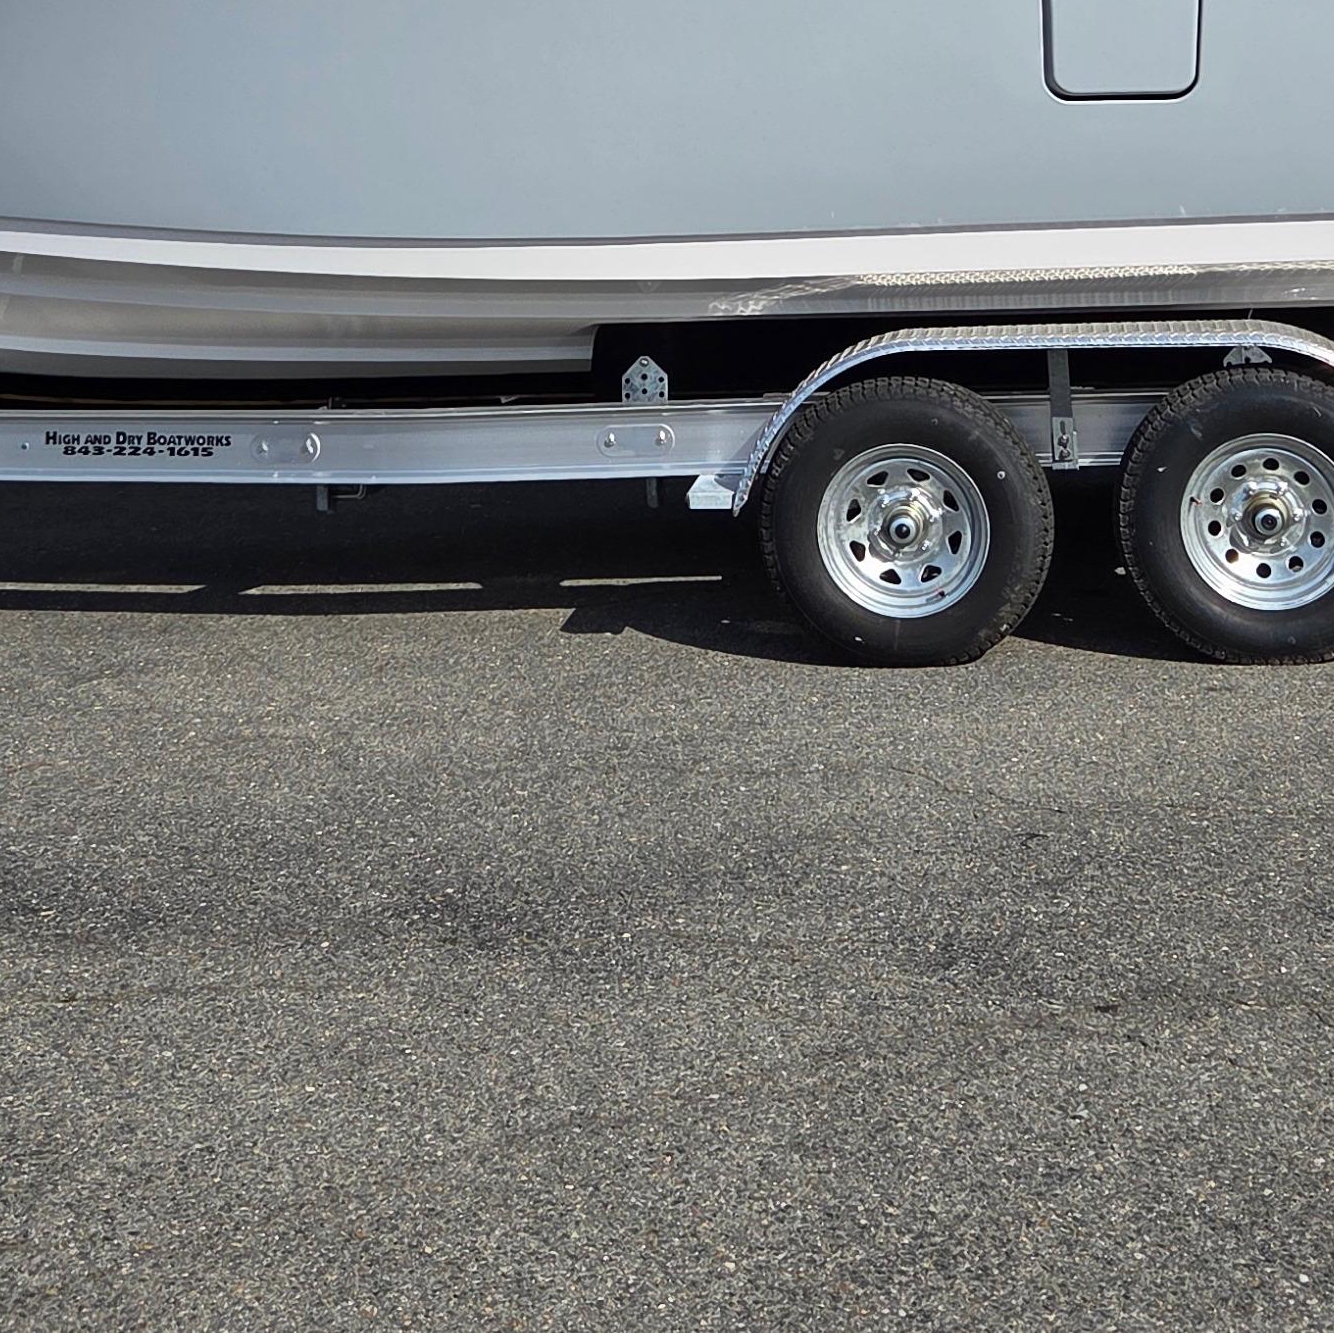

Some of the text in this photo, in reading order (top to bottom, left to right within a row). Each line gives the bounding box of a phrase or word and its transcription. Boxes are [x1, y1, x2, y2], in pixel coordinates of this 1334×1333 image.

[45, 431, 232, 447] HIGH AND DRY BOATWORKS
[62, 446, 215, 457] 843-224-1615
